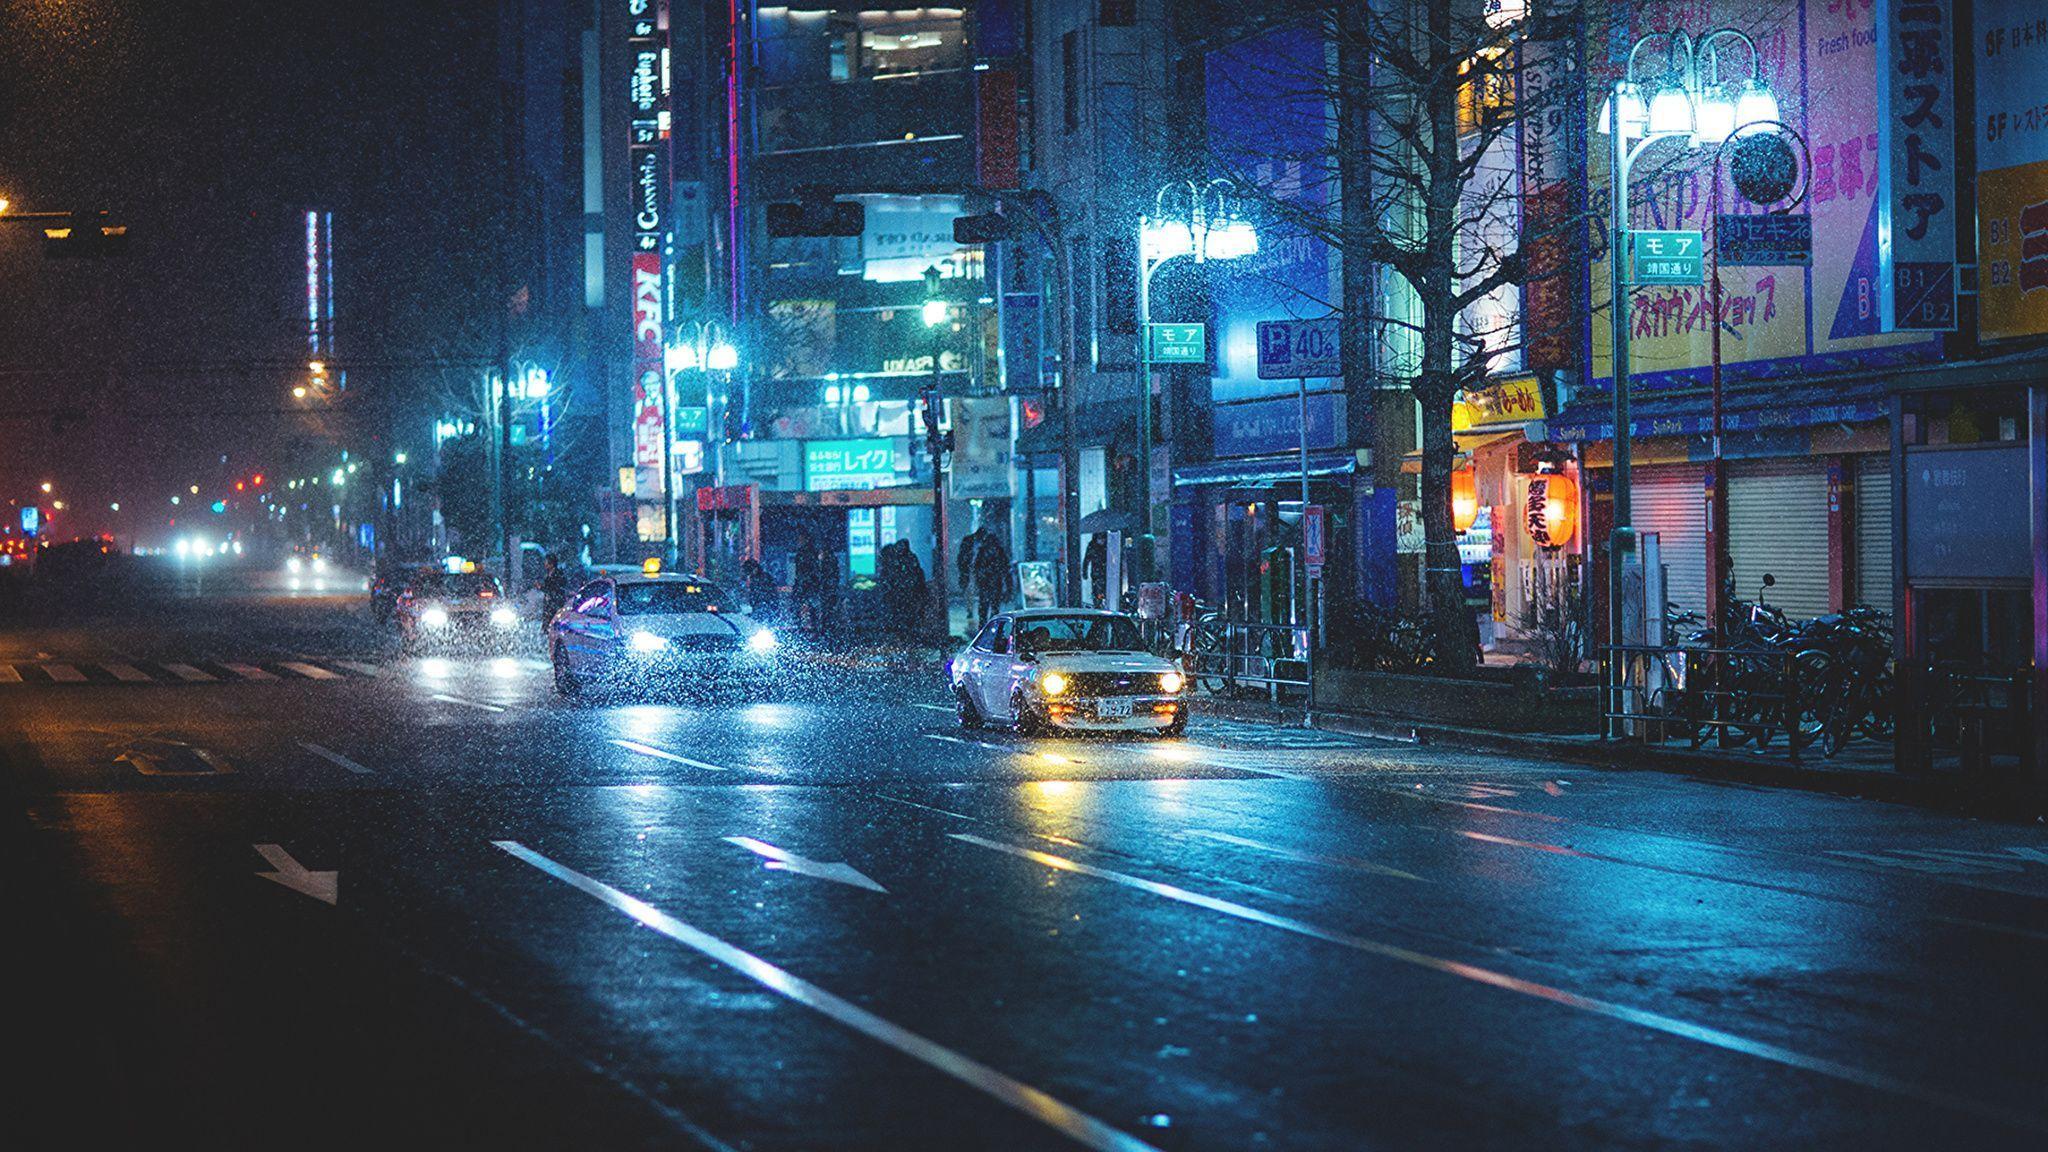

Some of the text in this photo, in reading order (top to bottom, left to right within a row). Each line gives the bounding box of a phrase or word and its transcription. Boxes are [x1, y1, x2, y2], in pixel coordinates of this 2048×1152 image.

[1818, 30, 1849, 57] Fresh
[1990, 218, 2009, 244] B1
[1647, 263, 1692, 275] 靖国通り
[1899, 268, 1925, 288] B1
[1991, 260, 2010, 287] B2
[636, 268, 662, 343] KFC
[1922, 302, 1950, 322] B2
